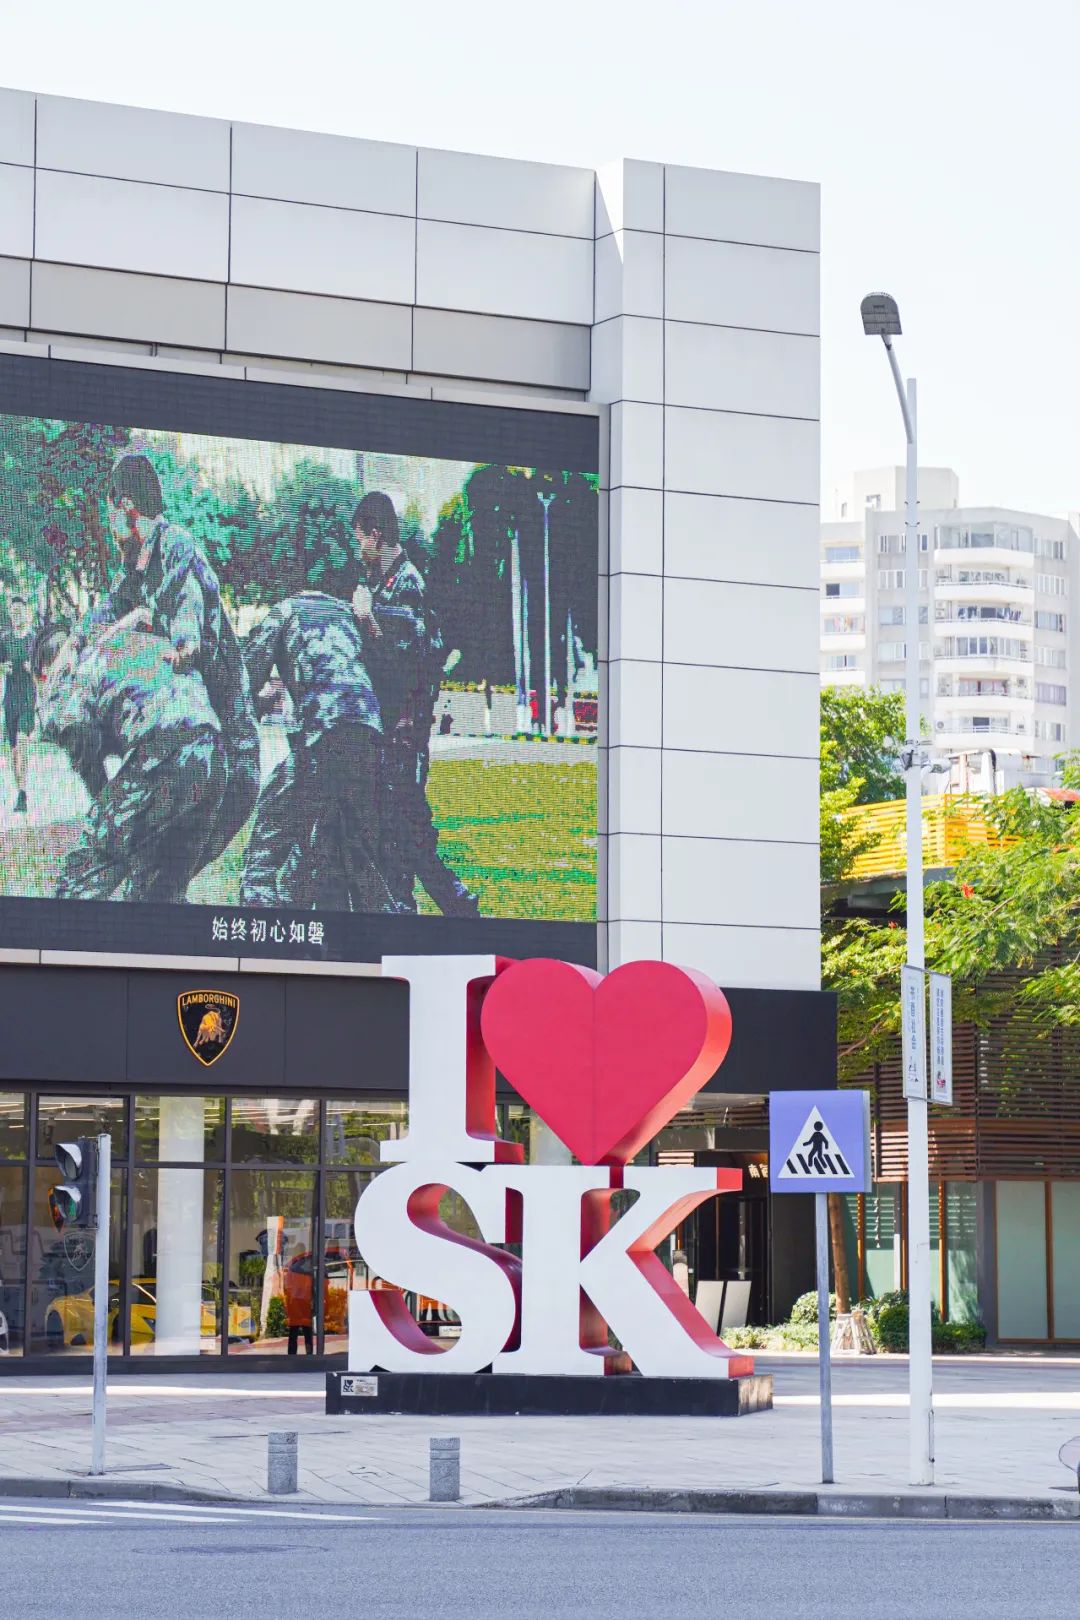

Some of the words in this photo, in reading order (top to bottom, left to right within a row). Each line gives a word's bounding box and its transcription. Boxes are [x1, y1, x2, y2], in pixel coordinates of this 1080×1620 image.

[212, 916, 324, 945] 始终初心如磐
[182, 993, 236, 1008] LAMBORGHINI
[380, 955, 498, 1163] I
[348, 1162, 745, 1377] SK
